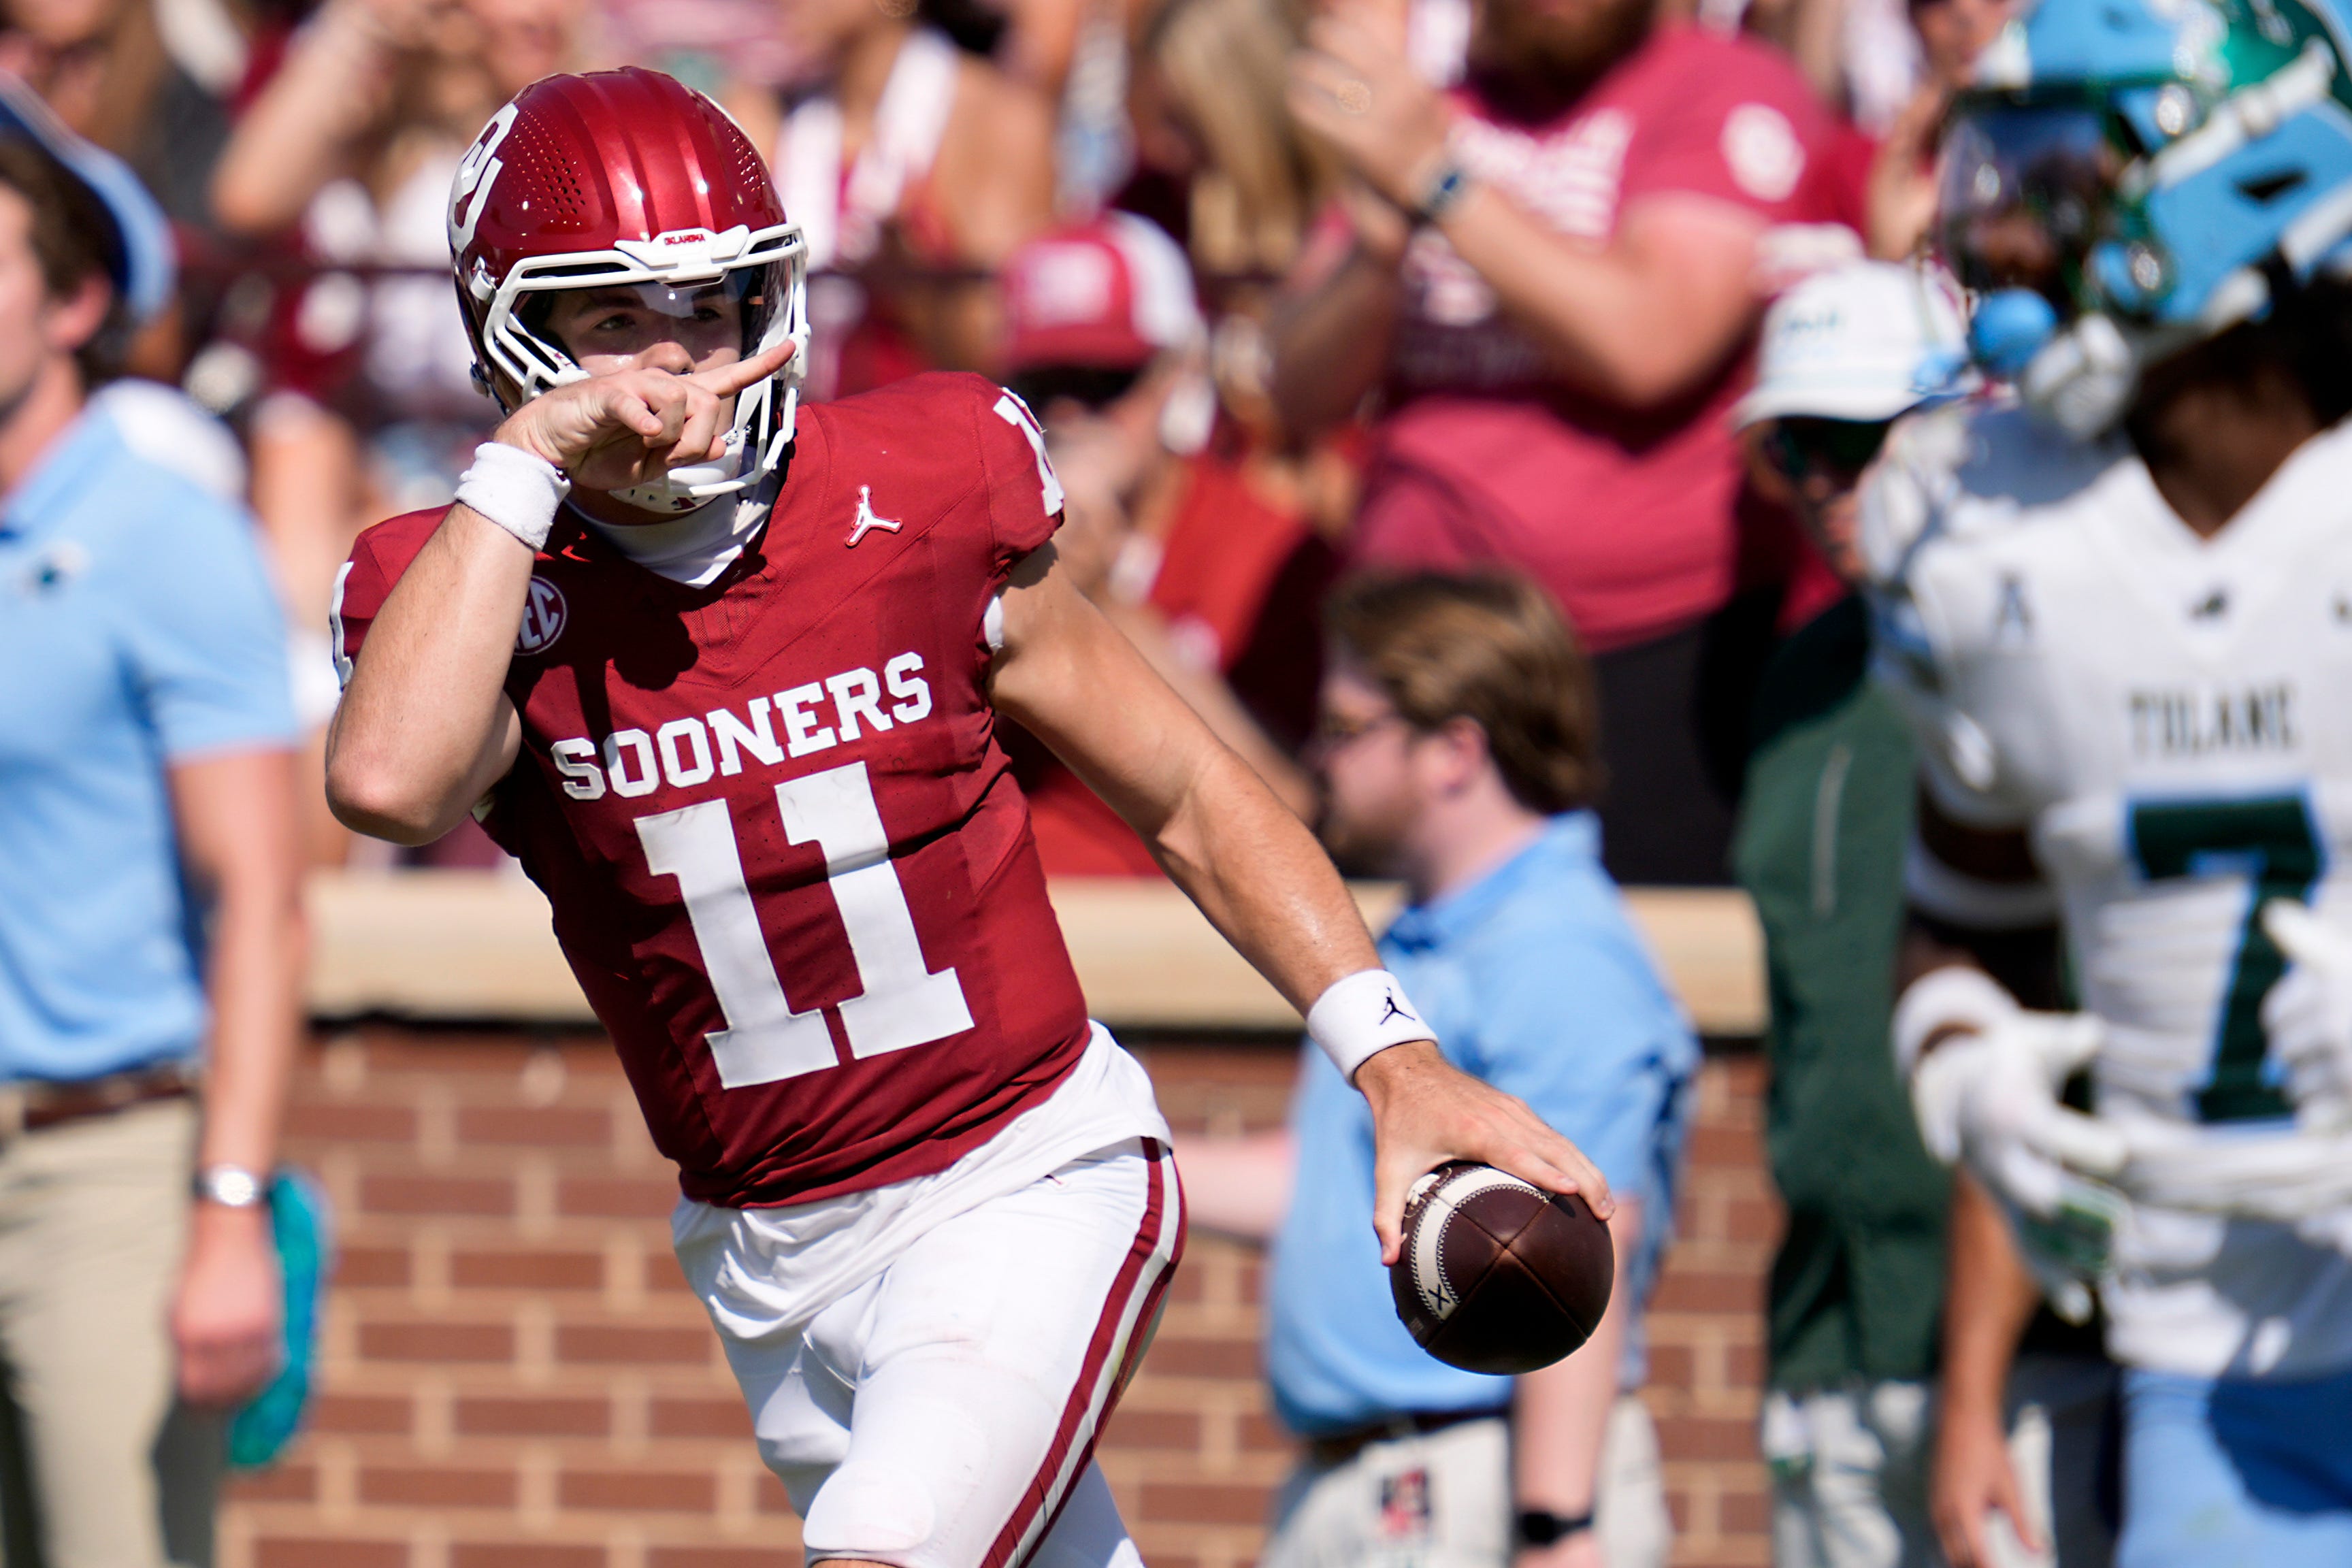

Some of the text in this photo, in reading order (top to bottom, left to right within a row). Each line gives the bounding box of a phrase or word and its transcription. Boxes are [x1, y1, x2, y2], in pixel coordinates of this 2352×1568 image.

[664, 233, 705, 245] OKLAHOMA
[514, 581, 559, 649] EC
[551, 651, 933, 800] SOONERS
[2129, 683, 2304, 755] TULANE
[633, 760, 974, 1090] 11
[2121, 788, 2325, 1137] 7
